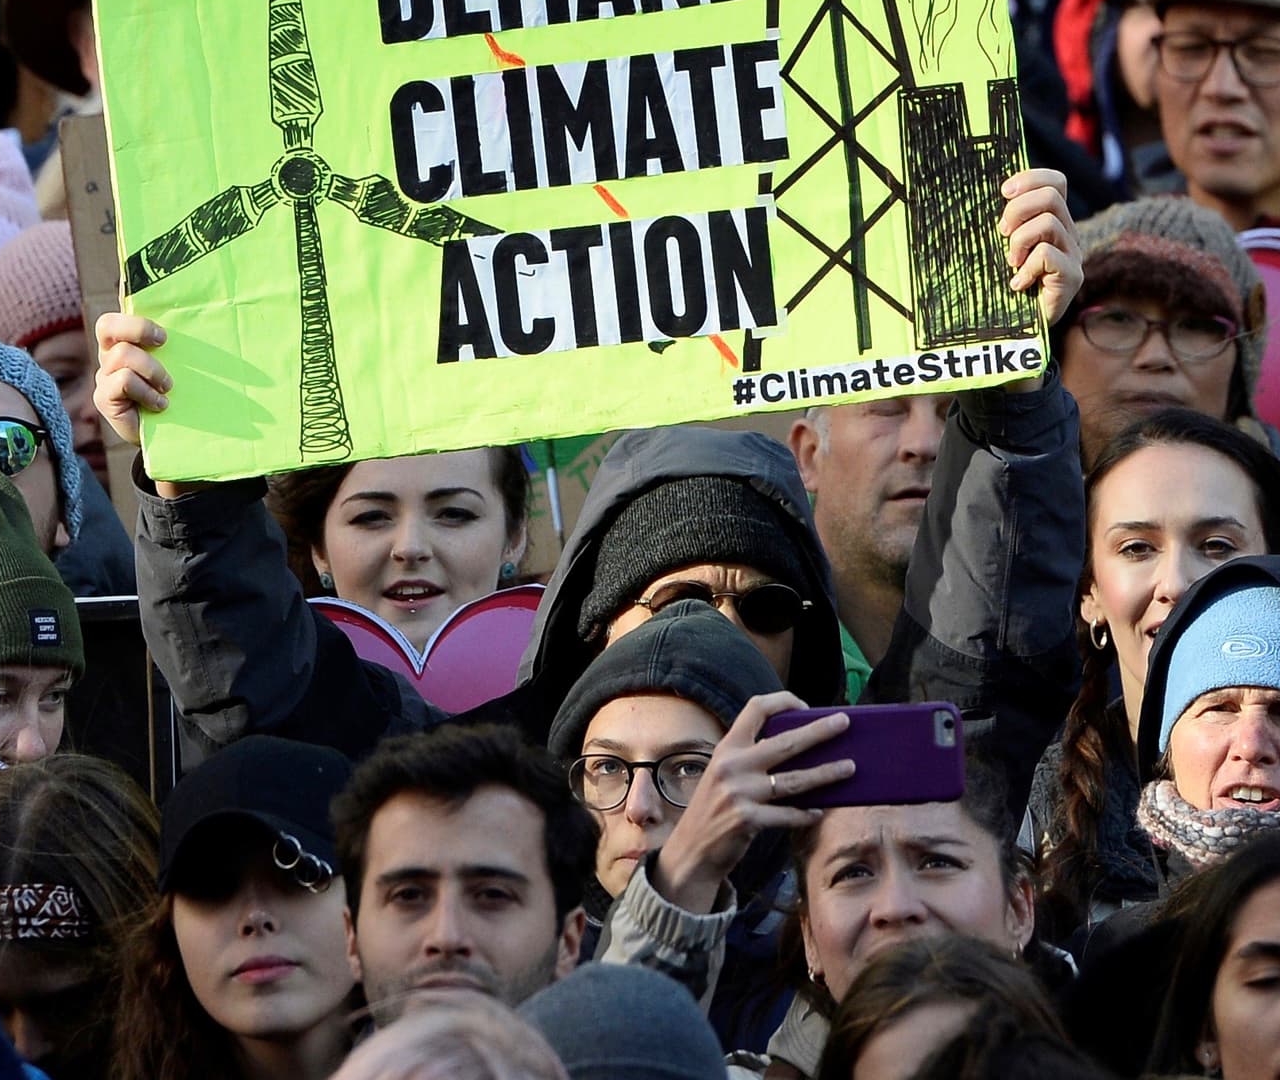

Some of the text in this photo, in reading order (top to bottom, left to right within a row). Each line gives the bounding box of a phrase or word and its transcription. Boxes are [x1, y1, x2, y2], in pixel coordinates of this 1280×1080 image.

[390, 39, 789, 205] CLIMATE
[436, 206, 778, 364] ACTION
[732, 344, 1042, 405] #ClimateStrike
